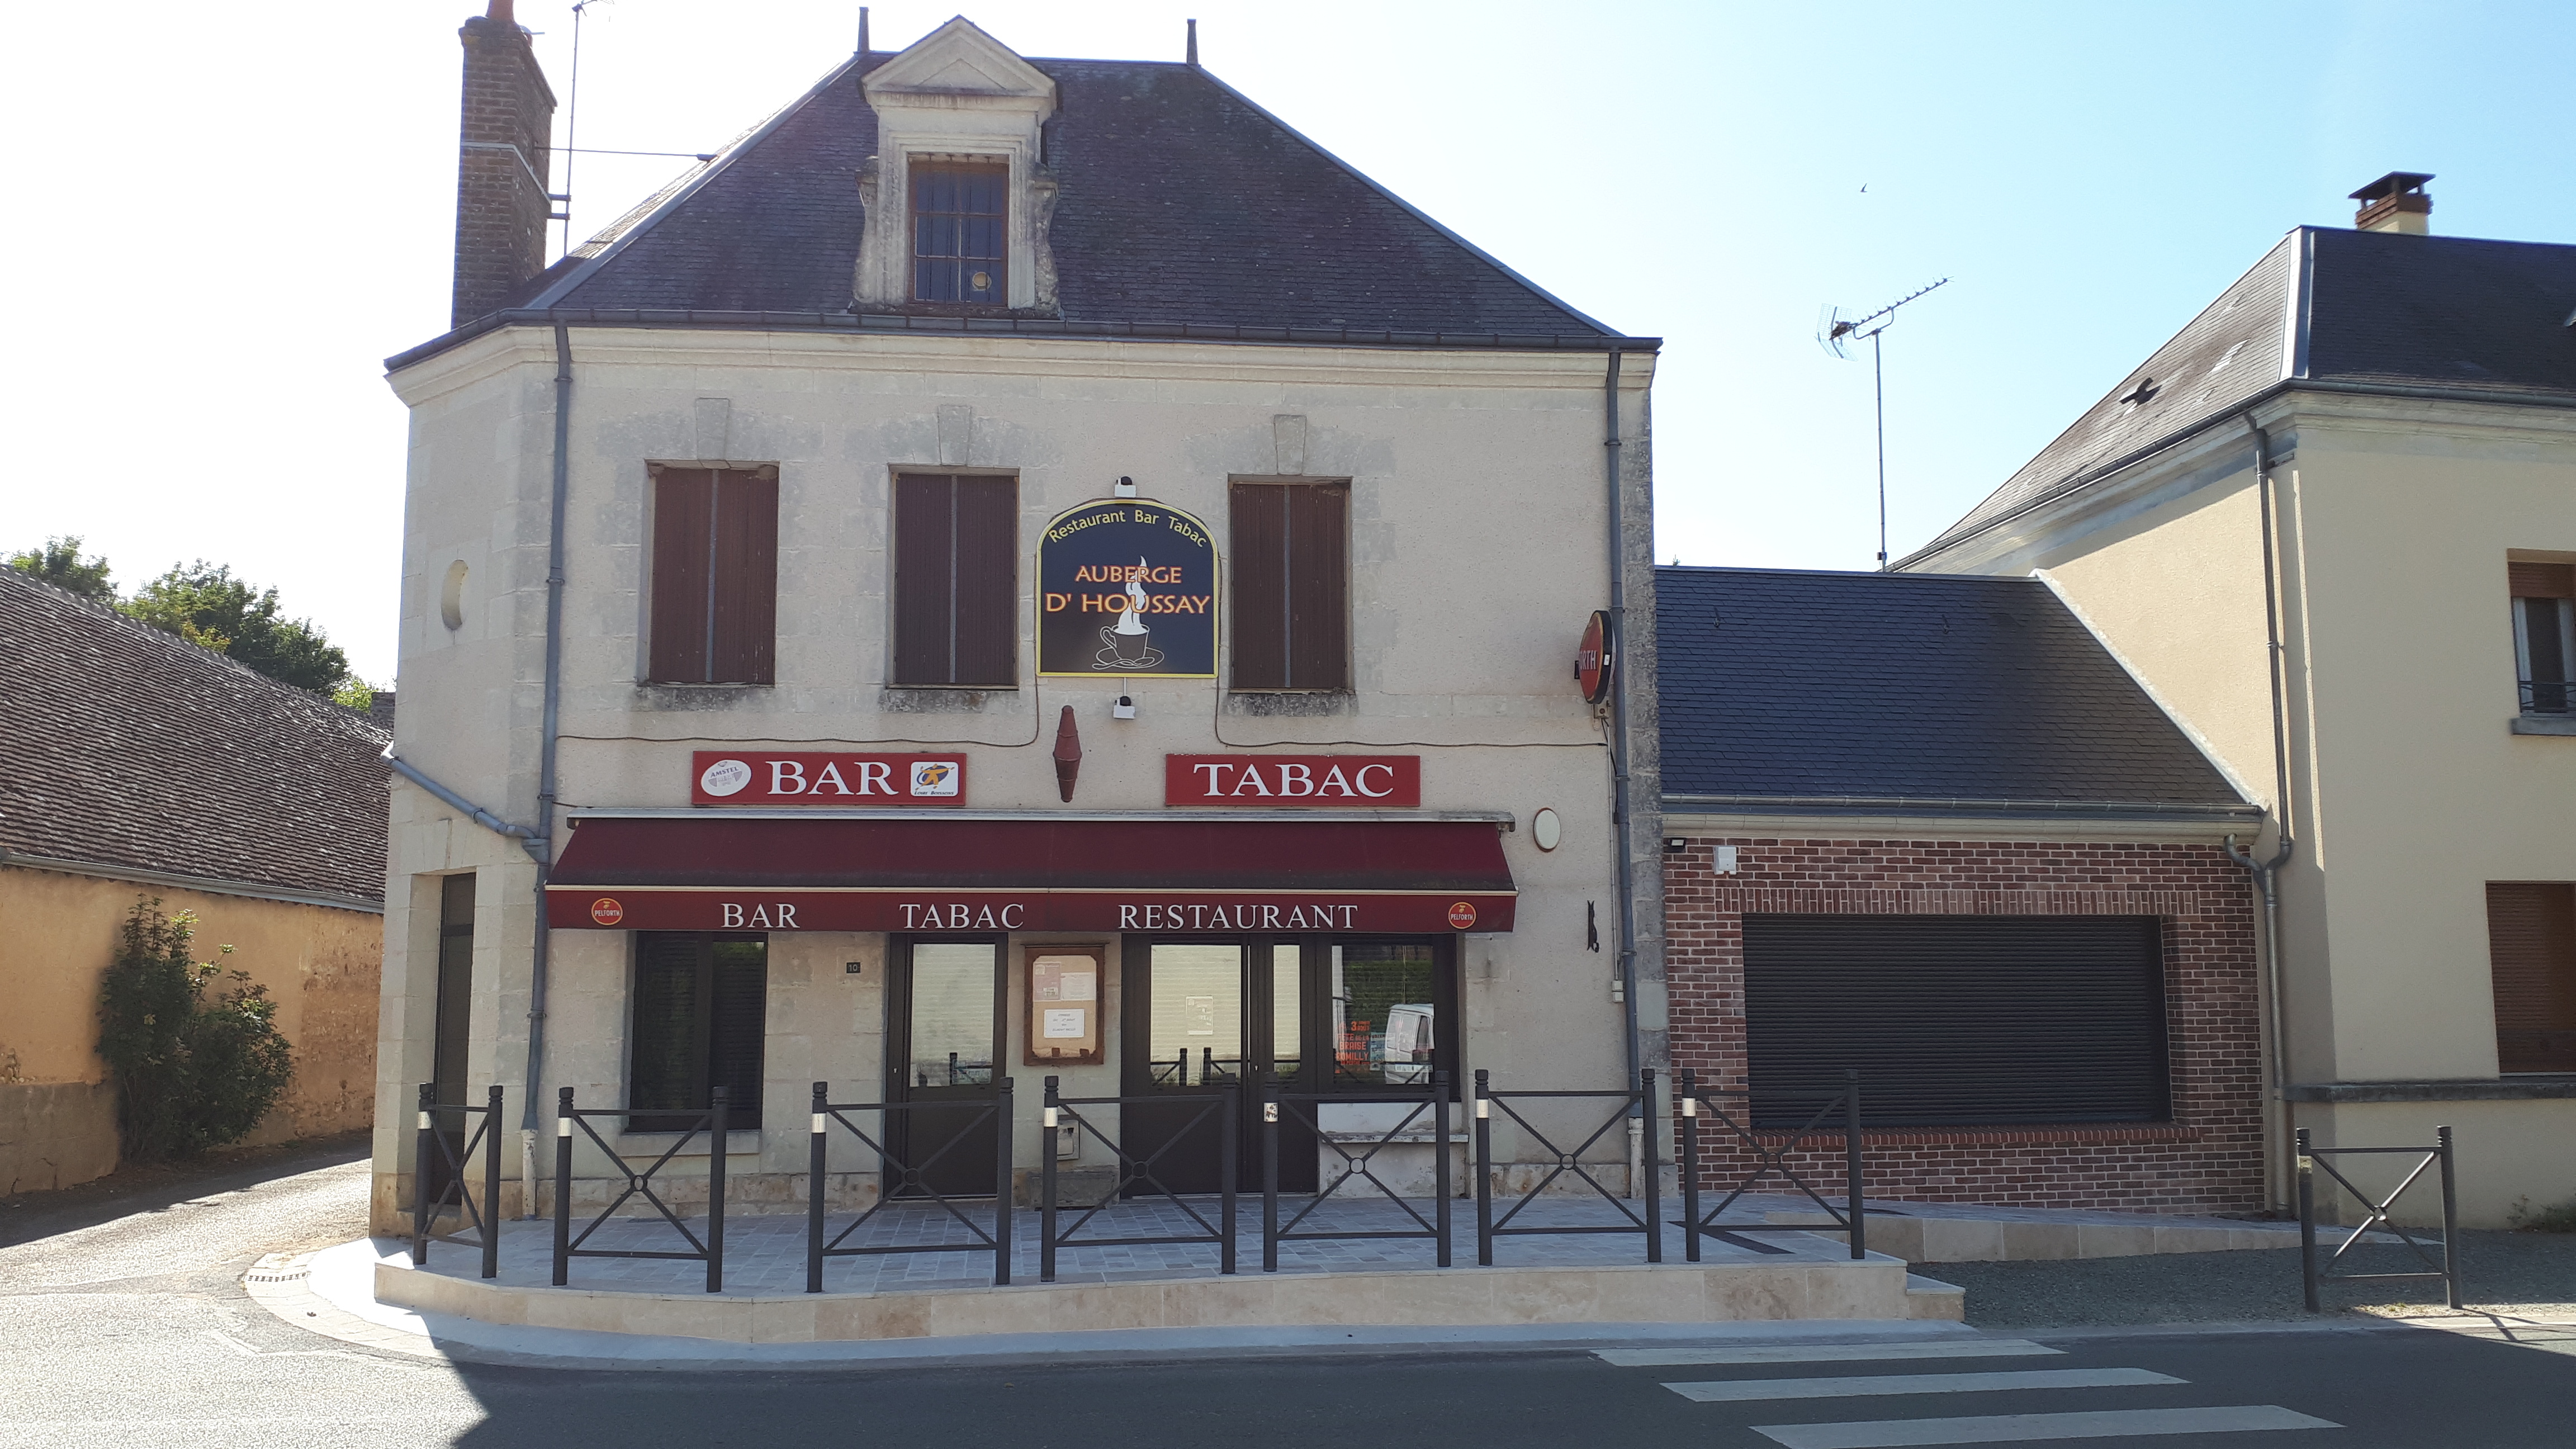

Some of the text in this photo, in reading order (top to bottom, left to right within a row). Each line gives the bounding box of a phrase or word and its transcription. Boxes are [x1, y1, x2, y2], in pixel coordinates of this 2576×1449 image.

[1049, 509, 1207, 547] Restaurant Bar Tabac
[1074, 565, 1182, 584] AUBERGE
[1081, 593, 1210, 614] HOUSSAY
[711, 766, 738, 778] AMSTEL
[765, 760, 899, 795] BAR
[1193, 763, 1394, 797] TABAC
[721, 903, 1358, 930] BAR TABAC RESTAURANT
[849, 964, 858, 972] 10
[1351, 1021, 1357, 1031] 3
[1339, 1041, 1367, 1050] BRAISE
[1336, 1052, 1369, 1061] ROMILLY
